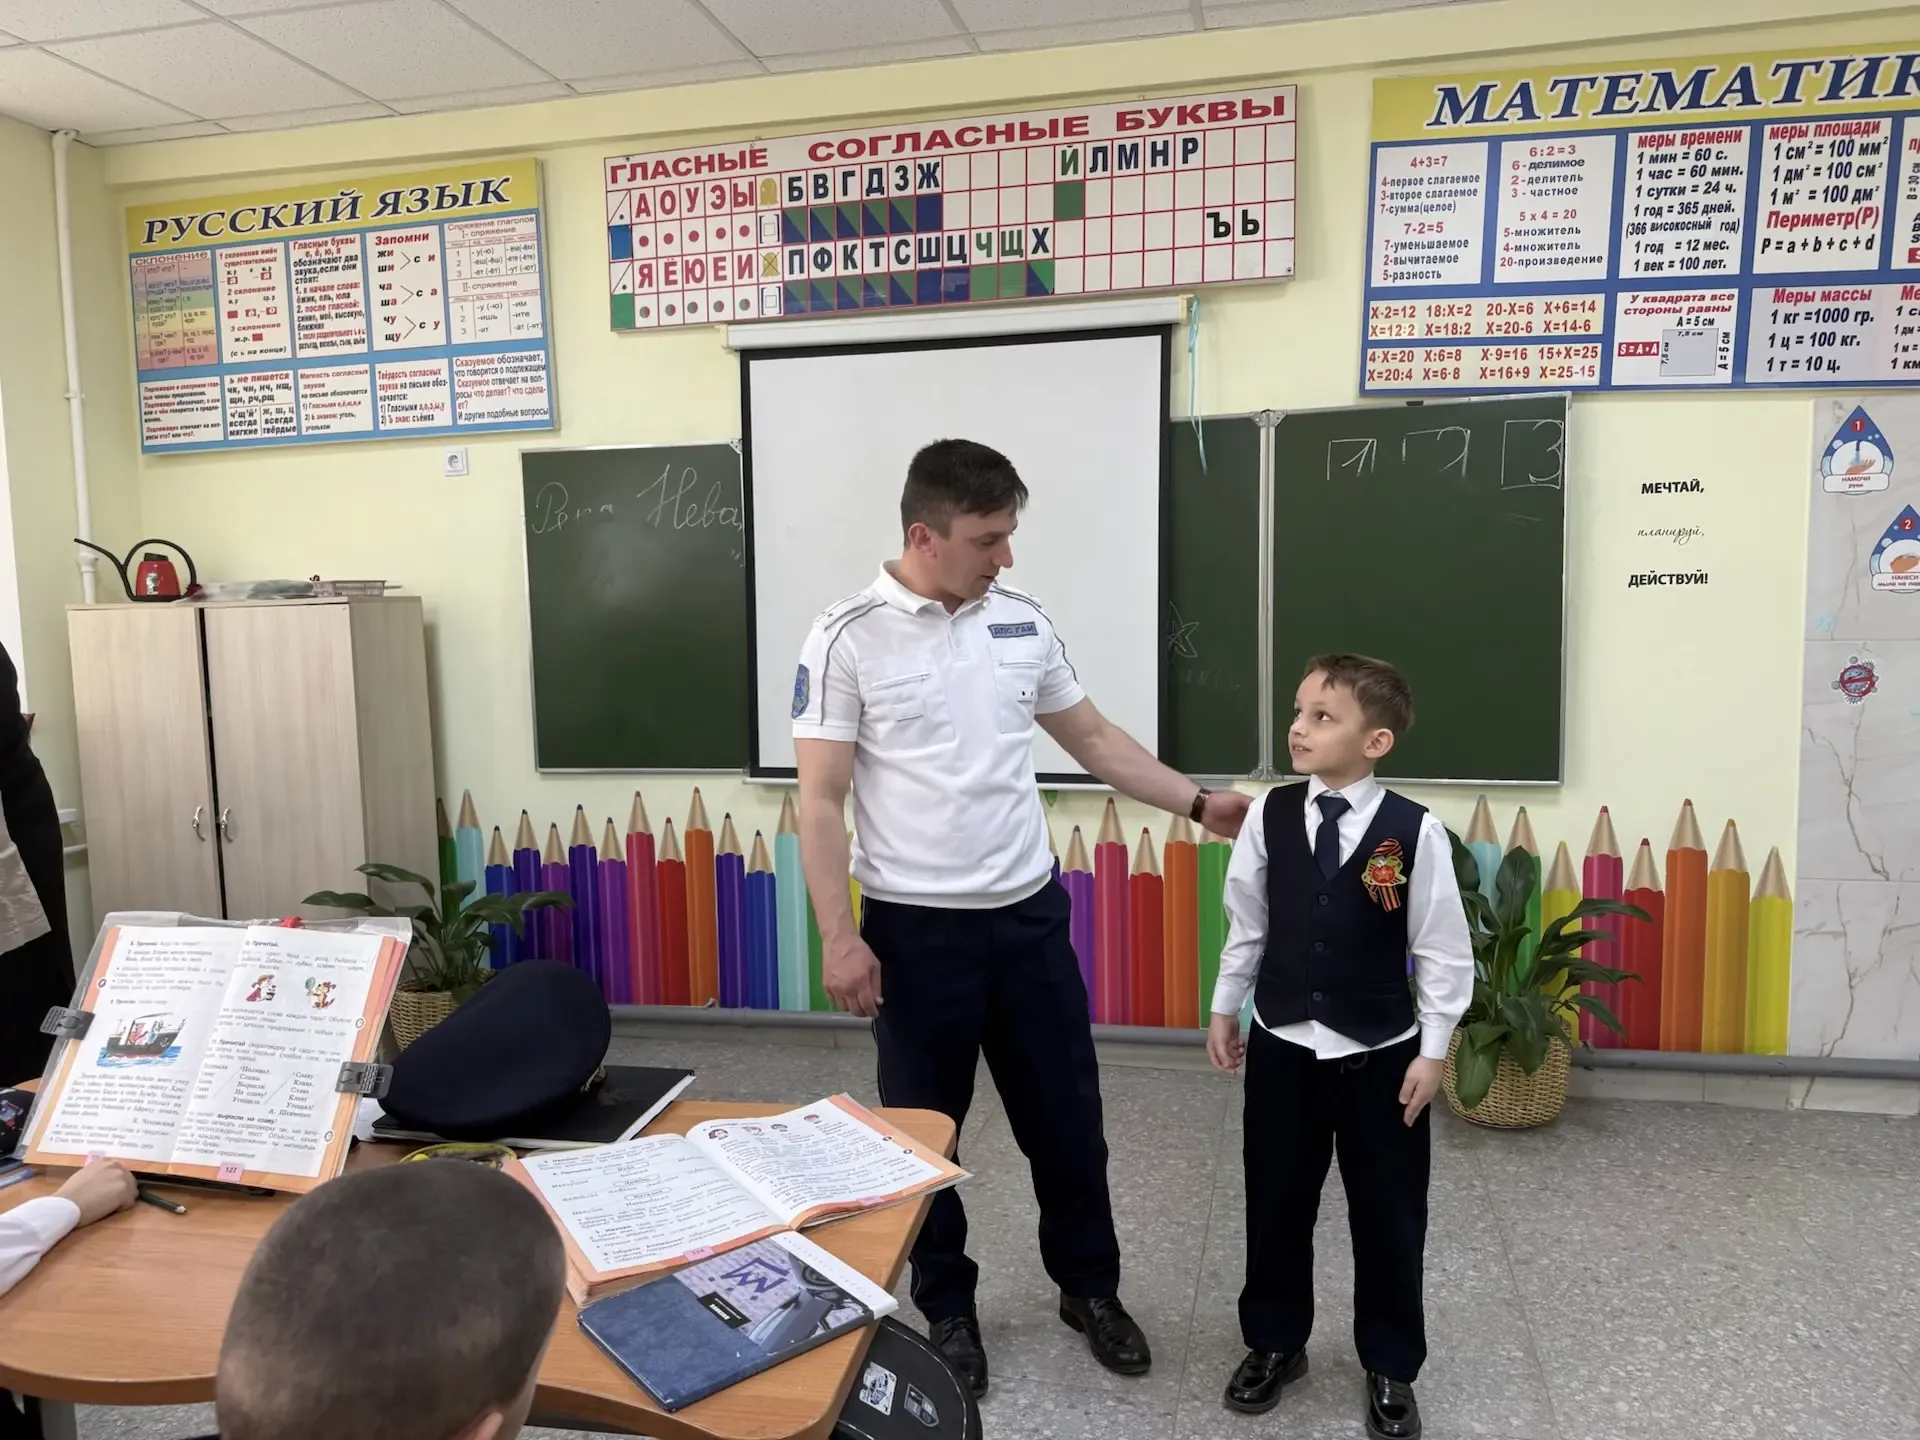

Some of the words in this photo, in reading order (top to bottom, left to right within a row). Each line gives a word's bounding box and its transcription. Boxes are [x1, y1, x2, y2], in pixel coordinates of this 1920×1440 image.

[1769, 124, 1808, 142] меры
[1813, 120, 1880, 140] площади
[610, 148, 769, 183] ГЛАСНЫЕ
[807, 115, 1090, 162] СОГЛАСНЫЕ
[1116, 96, 1285, 132] БУКВЫ
[1638, 133, 1676, 150] меры
[1680, 128, 1742, 146] времени
[1061, 145, 1078, 175] Й
[1089, 146, 1108, 173] Л
[1118, 143, 1139, 170] М
[1151, 141, 1169, 167] Н
[1182, 138, 1198, 164] Р
[1410, 156, 1447, 168] 4+3=7
[1649, 152, 1676, 164] мин
[1694, 148, 1710, 161] 60
[1648, 168, 1672, 180] час
[1690, 166, 1706, 178] 60
[1711, 164, 1744, 178] мин.
[788, 176, 803, 202] Б
[814, 174, 828, 199] В
[842, 170, 855, 196] Г
[866, 168, 885, 197] Д
[895, 165, 909, 191] З
[918, 162, 940, 189] Ж
[1382, 176, 1423, 188] 4-первое
[1427, 174, 1480, 186] слагаемое
[1381, 189, 1422, 202] 3-второе
[1426, 187, 1478, 199] слагаемое
[1530, 186, 1578, 197] частное
[1647, 185, 1686, 200] сутки
[1703, 182, 1720, 194] 24
[635, 193, 651, 218] А
[660, 190, 675, 215] О
[686, 187, 700, 212] У
[710, 185, 726, 210] Э
[733, 181, 754, 208] Ы
[142, 191, 364, 244] РУССКИЙ
[370, 176, 510, 220] ЯЗЫК
[1380, 201, 1456, 217] 7-сумма(целое)
[1644, 204, 1663, 218] год
[1677, 202, 1698, 215] 365
[1701, 200, 1735, 215] дней.
[448, 220, 494, 231] Спряжение
[497, 217, 534, 226] глаголов
[1206, 212, 1231, 238] Ъ
[1242, 210, 1260, 236] Ь
[1404, 222, 1443, 234] 7-2=5
[1626, 221, 1646, 236] (366
[1650, 219, 1712, 232] високосный
[1720, 218, 1740, 235] год)
[1504, 227, 1581, 236] 5-множитель
[293, 239, 328, 250] Гласные
[331, 237, 356, 247] буквы
[375, 233, 429, 246] Запомни
[1384, 239, 1469, 253] 7-уменьшаемое
[1644, 242, 1664, 255] год
[1686, 239, 1700, 252] 12
[1703, 238, 1729, 251] мес.
[378, 250, 394, 258] жи
[788, 249, 804, 275] П
[814, 247, 832, 272] Ф
[844, 244, 857, 270] К
[869, 242, 885, 267] Т
[895, 239, 910, 265] С
[918, 237, 940, 263] Ш
[946, 235, 967, 264] Ц
[976, 232, 992, 258] Ч
[1001, 229, 1024, 258] Щ
[1032, 227, 1050, 254] Х
[1503, 242, 1580, 252] 4-множитель
[136, 251, 208, 265] склонение
[293, 256, 342, 268] обозначают
[344, 254, 358, 263] два
[1384, 254, 1459, 265] 2-вычитаемое
[1500, 255, 1603, 268] 20-произведение
[1644, 261, 1664, 271] век
[1679, 258, 1700, 270] 100
[1702, 258, 1726, 270] лет.
[638, 263, 653, 288] Я
[665, 257, 678, 285] Ё
[685, 258, 705, 284] Ю
[713, 256, 726, 282] Е
[738, 254, 753, 279] И
[1383, 270, 1442, 283] 5-разность
[295, 276, 319, 284] стоят:
[1642, 294, 1706, 304] квадрата
[1710, 292, 1735, 301] все
[1773, 288, 1815, 304] Меры
[1820, 288, 1872, 302] массы
[1624, 305, 1683, 316] стороны
[1689, 304, 1732, 313] равны
[1854, 310, 1874, 324] гр.
[384, 315, 396, 324] чу
[1810, 332, 1836, 348] 100
[1840, 332, 1860, 347] кг.
[455, 356, 495, 368] Сказуемое
[497, 354, 543, 365] обозначает,
[466, 367, 498, 377] говорится
[505, 363, 546, 374] подлежащем
[251, 372, 290, 384] пишется
[457, 378, 490, 388] Сказуемое
[491, 377, 520, 386] отвечает
[485, 387, 511, 398] делает?
[265, 416, 293, 425] всегда
[464, 410, 486, 421] другие
[487, 408, 519, 419] подобные
[520, 408, 548, 418] вопросы
[229, 418, 257, 427] всегда
[263, 424, 296, 435] твёрдые
[1856, 420, 1861, 430] 1
[229, 428, 258, 436] мягкие
[1641, 479, 1704, 494] МЕЧТАЙ,
[1904, 519, 1911, 529] 2
[1638, 526, 1704, 546] планируй,
[1628, 570, 1708, 588] ДЕЙСТВУЙ!
